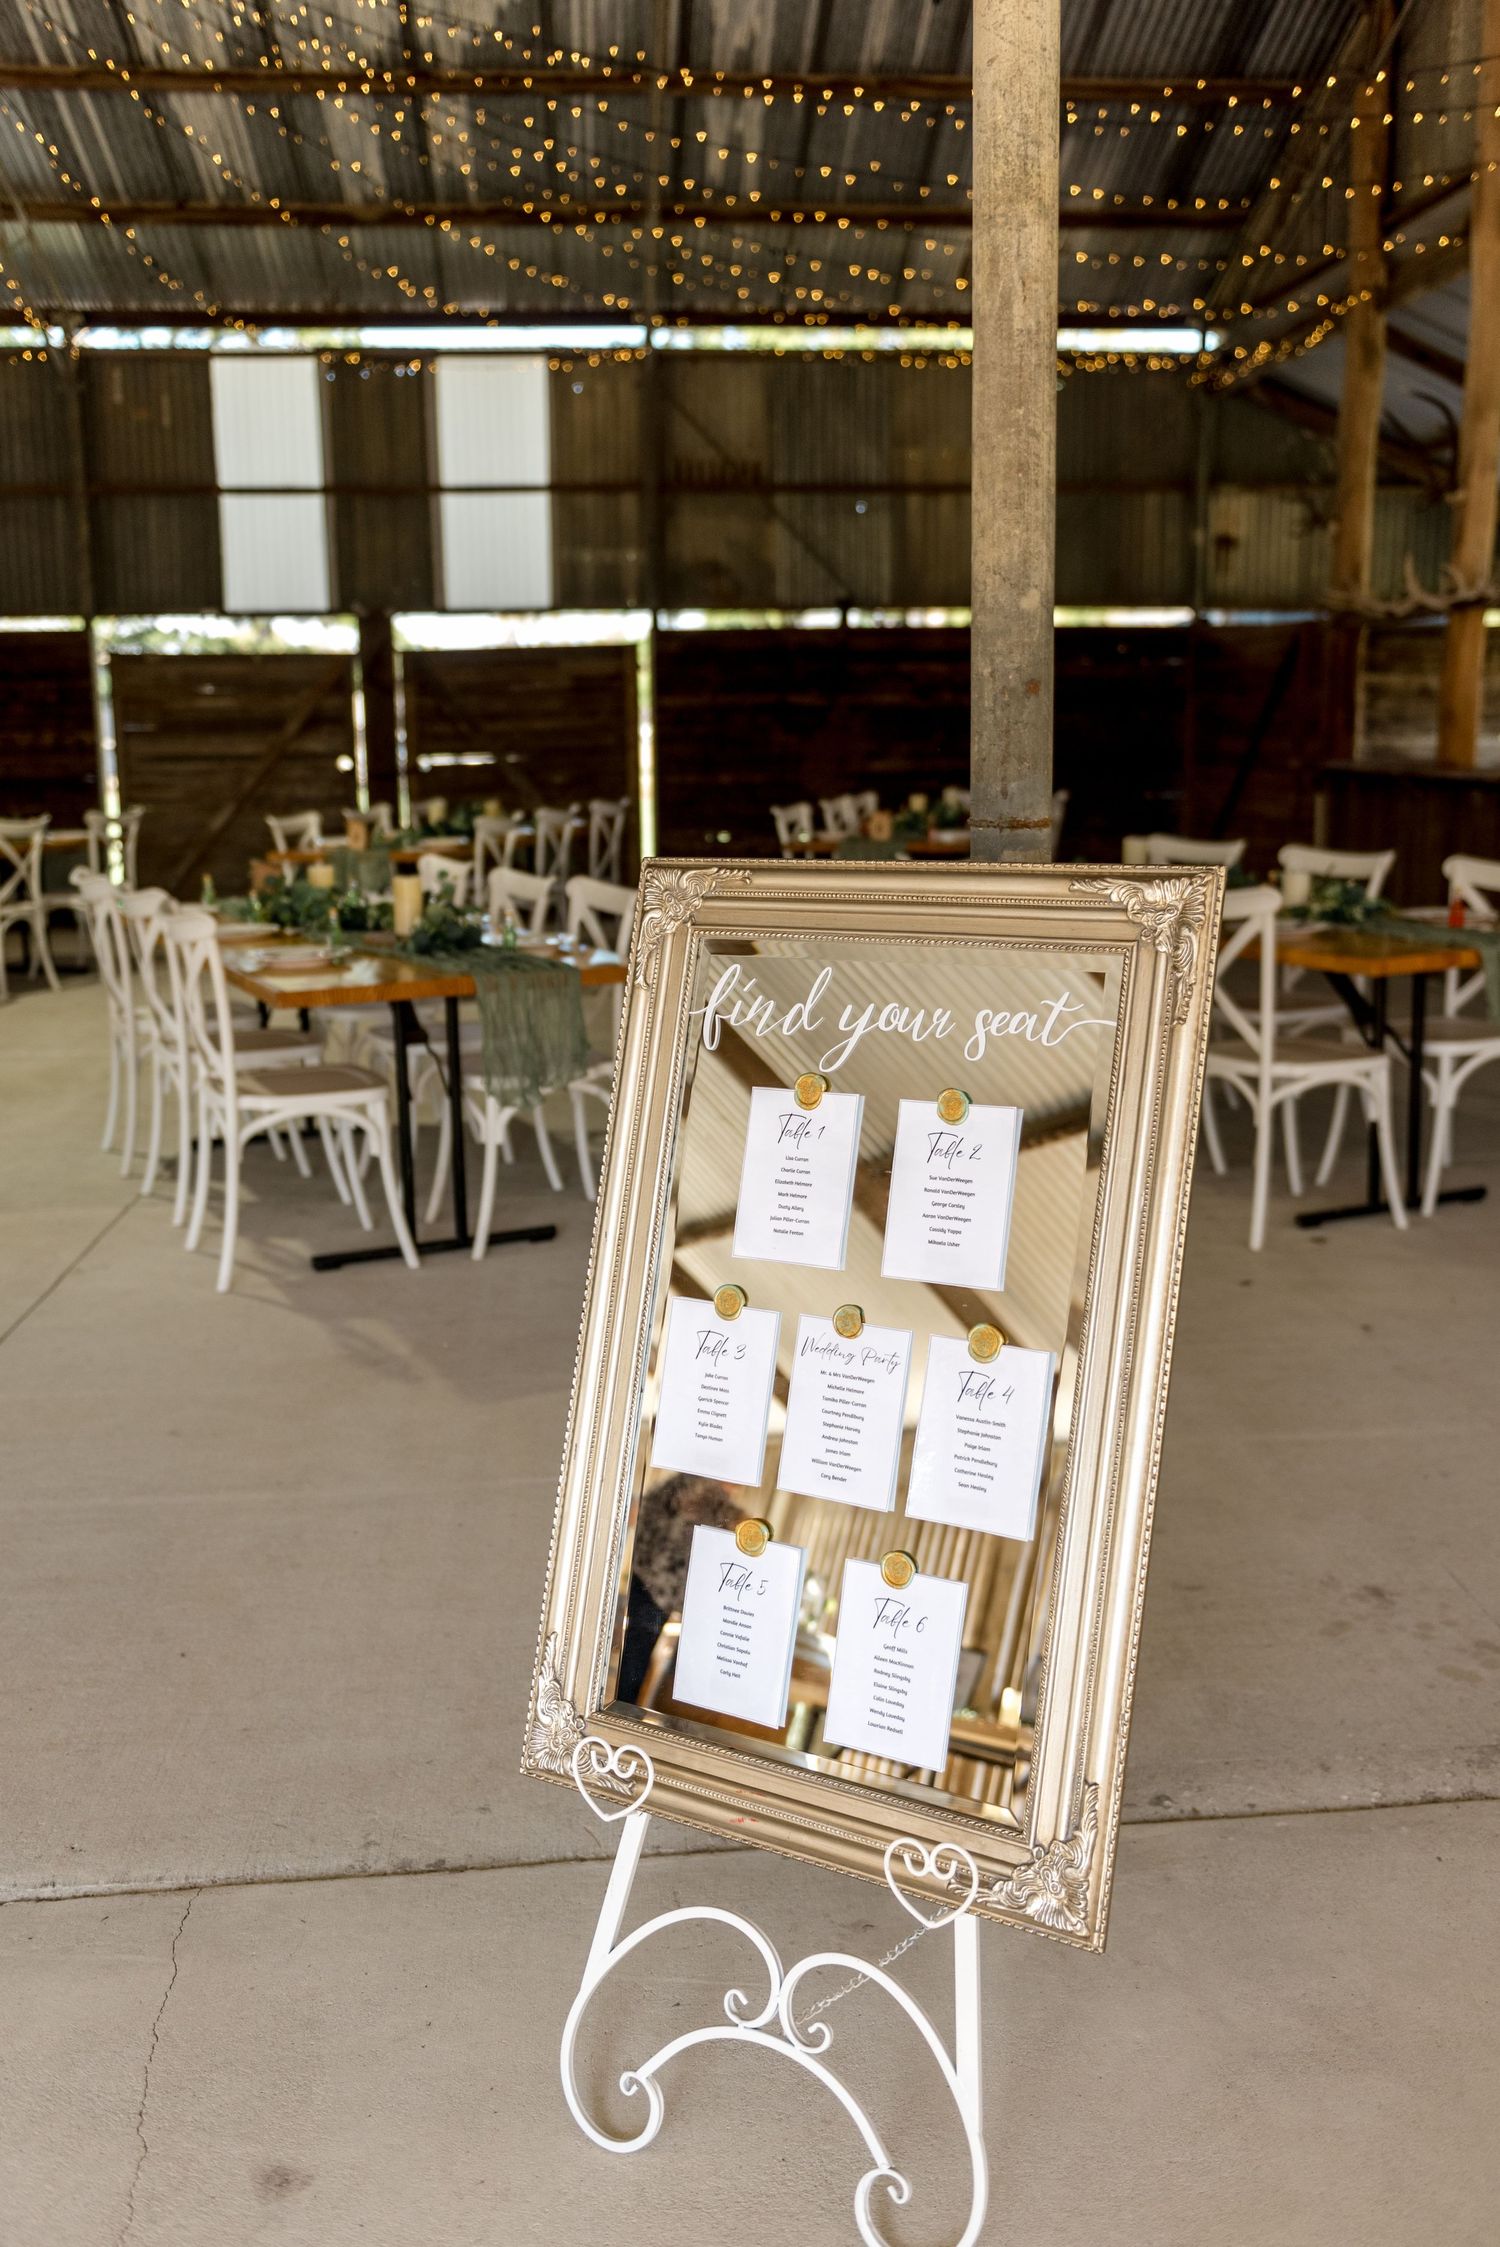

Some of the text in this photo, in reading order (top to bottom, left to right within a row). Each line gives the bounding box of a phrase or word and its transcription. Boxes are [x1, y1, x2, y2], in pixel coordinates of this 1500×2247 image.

[689, 964, 1118, 1072] find your seat
[777, 1113, 825, 1149] Table 1
[927, 1132, 983, 1169] Table 2
[696, 1330, 747, 1366] Table 3
[800, 1332, 901, 1375] Wedding Party
[958, 1371, 1015, 1411] Table 4
[718, 1563, 769, 1601] Table 5
[873, 1598, 928, 1638] Table 6
